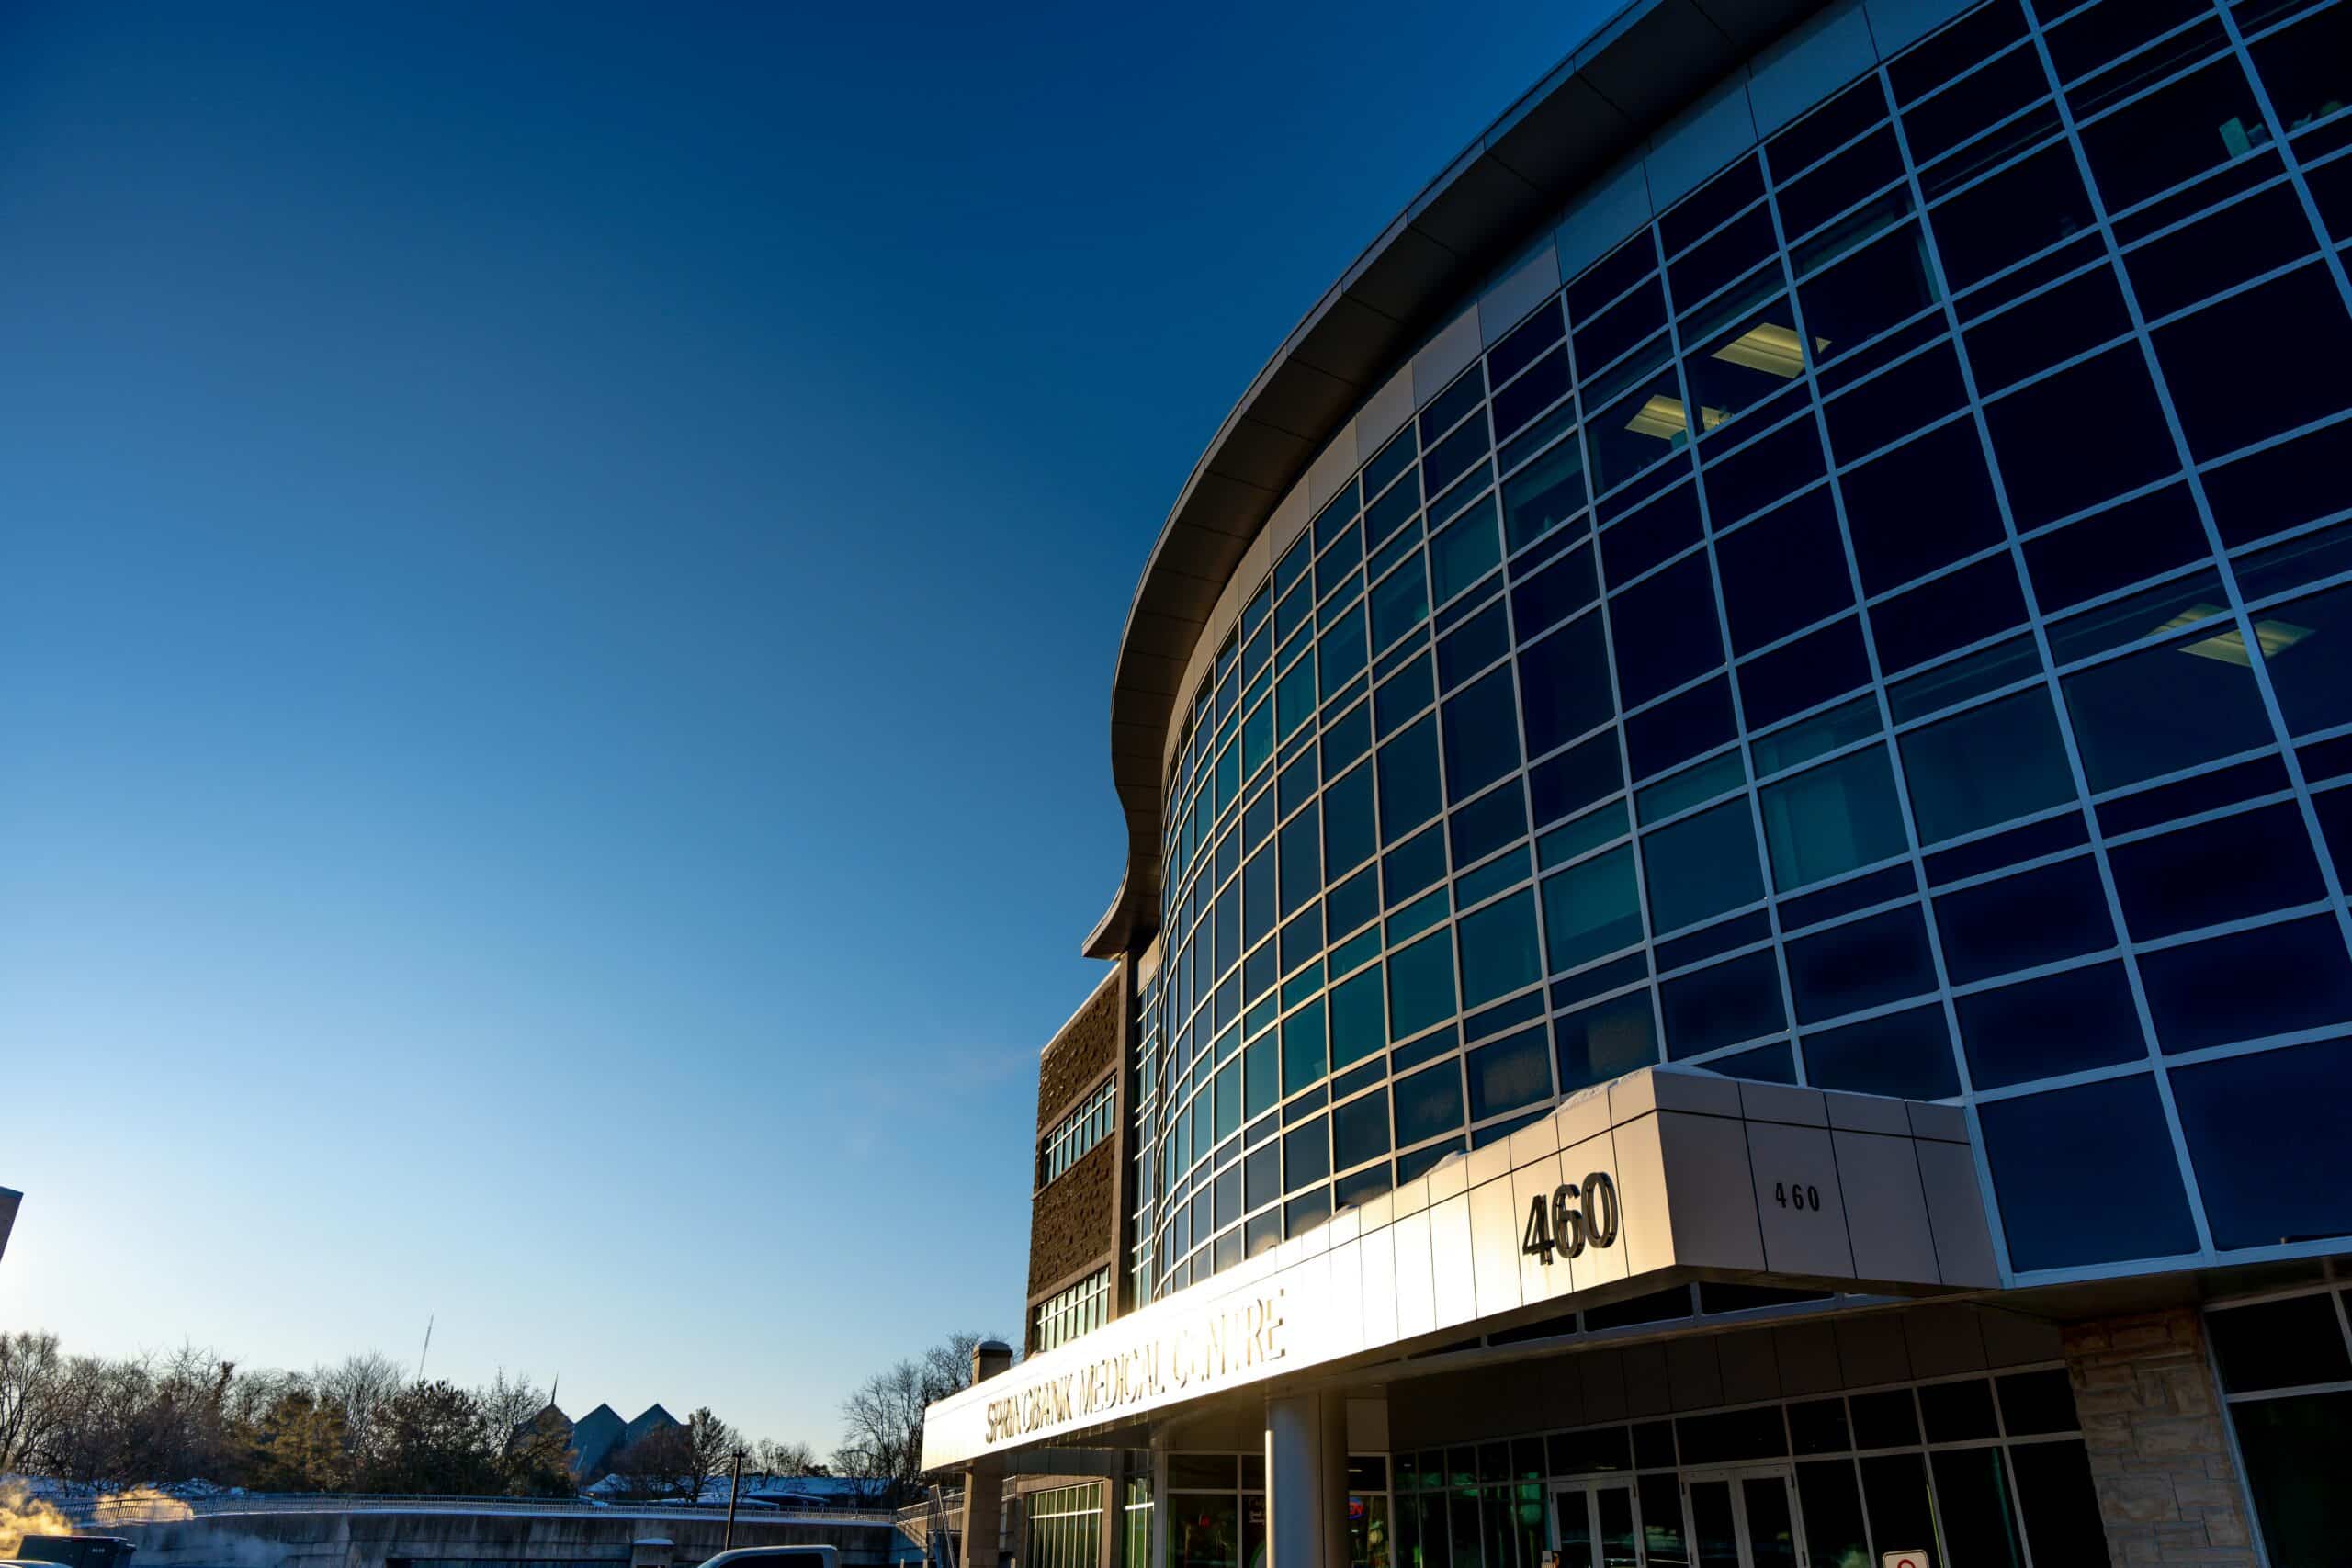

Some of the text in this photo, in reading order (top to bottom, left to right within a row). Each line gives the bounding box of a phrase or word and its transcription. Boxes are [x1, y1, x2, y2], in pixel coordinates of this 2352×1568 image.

[1522, 1172, 1618, 1265] 460
[1775, 1182, 1820, 1211] 460
[986, 1288, 1286, 1444] SPRINGBANK MEDICAL CNTRE
